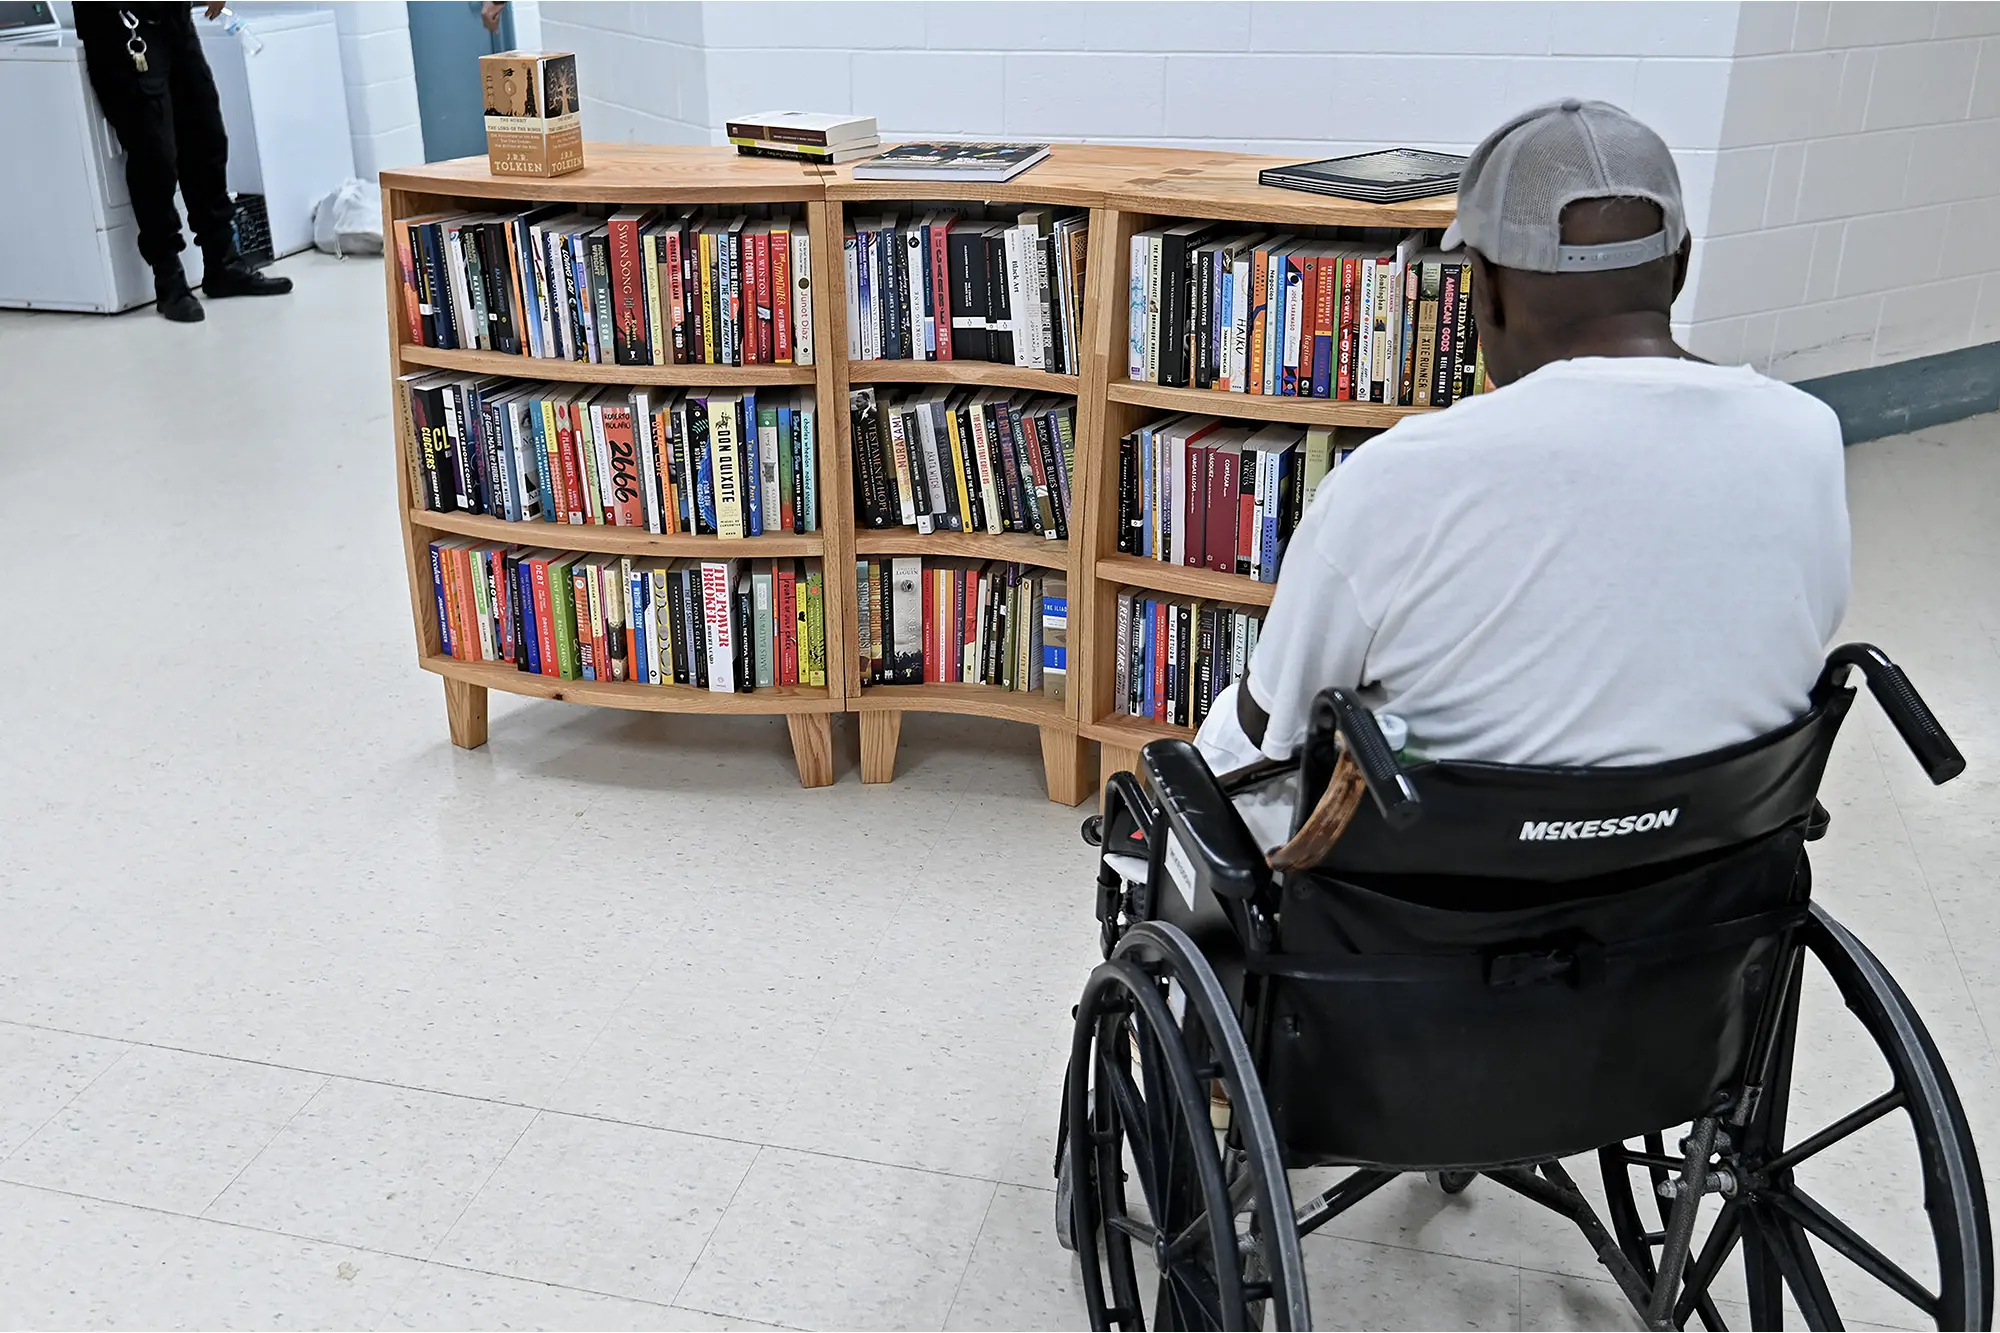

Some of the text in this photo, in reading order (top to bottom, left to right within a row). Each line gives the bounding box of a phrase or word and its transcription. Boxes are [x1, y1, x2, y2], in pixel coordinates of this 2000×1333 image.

[494, 161, 542, 172] TOLKIEN
[506, 154, 528, 162] J.R.R.
[552, 156, 582, 172] TOLKIEN
[562, 249, 572, 277] LOVING
[592, 245, 600, 275] WRIGHT
[617, 224, 632, 294] SWAN SONG
[670, 236, 678, 262] CROOKED
[670, 265, 679, 300] HALLELUJAH
[746, 262, 754, 284] COUNTS
[773, 260, 786, 306] SYMPATHIZER
[472, 276, 482, 305] NATIVE
[598, 289, 608, 319] NATIVE
[1377, 274, 1387, 311] Bombingham
[1236, 318, 1246, 356] HAIKU
[1439, 276, 1456, 369] AMERICAN GODS NEIL
[1454, 294, 1467, 380] FRIDAY BLACK
[1302, 334, 1313, 366] Ragtime
[1418, 338, 1431, 388] KITE RUNNER
[488, 436, 496, 454] MAN
[856, 426, 865, 452] MARTIN
[892, 417, 907, 468] MURAKAMI
[975, 424, 984, 448] SENTENCES
[421, 427, 436, 470] CLOCKERS
[431, 471, 440, 492] RICHARD
[718, 430, 735, 502] DON QUIXOTE
[859, 453, 868, 479] LUTHER
[868, 424, 887, 512] TESTAMENT HOPE
[977, 449, 985, 460] THAT
[1037, 420, 1057, 488] BLACK HOLE BLUES
[609, 441, 638, 503] 2666
[431, 551, 441, 585] Freedom
[535, 564, 544, 585] DEBT
[490, 589, 499, 619] O'BRIEN
[703, 568, 716, 623] BROKER
[714, 566, 729, 647] THE POWER
[858, 582, 869, 607] STORM
[1117, 605, 1128, 672] RESIDUE YEARS
